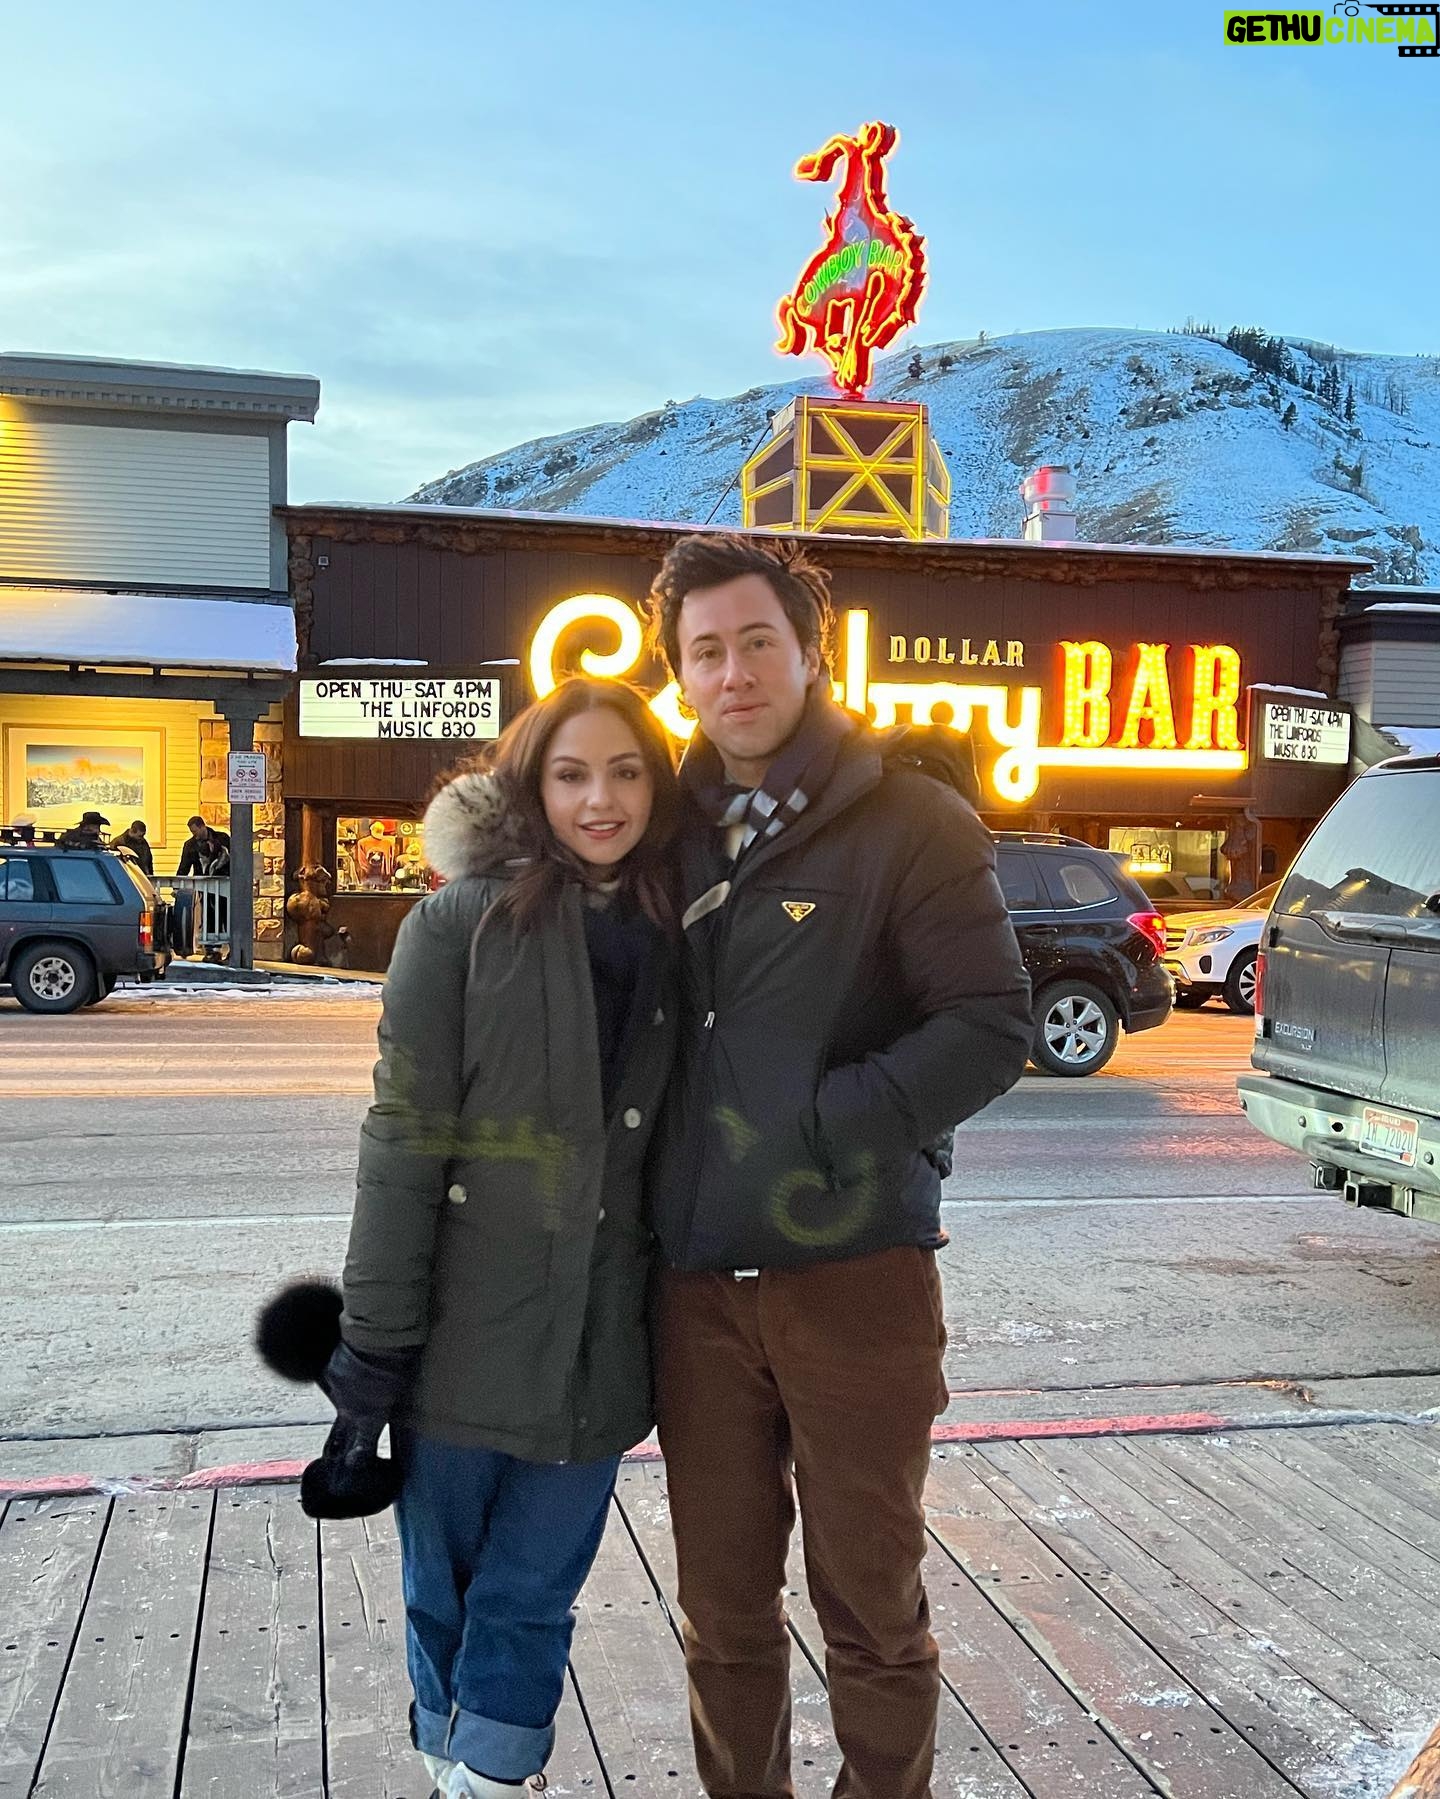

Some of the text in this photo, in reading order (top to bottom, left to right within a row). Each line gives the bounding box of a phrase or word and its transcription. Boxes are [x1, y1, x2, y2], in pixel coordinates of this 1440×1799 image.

[796, 240, 904, 317] COWBOY BAR
[888, 635, 1025, 667] DOLLAR
[316, 681, 362, 698] OPEN
[454, 681, 492, 699] 4PM
[1056, 640, 1246, 751] BAR
[360, 701, 492, 718] THE LINFORDS
[378, 721, 476, 738] MUSIC 830
[1270, 723, 1284, 740] THE
[1274, 742, 1317, 760] MUSIC 830
[1274, 1021, 1315, 1042] EXCURSION
